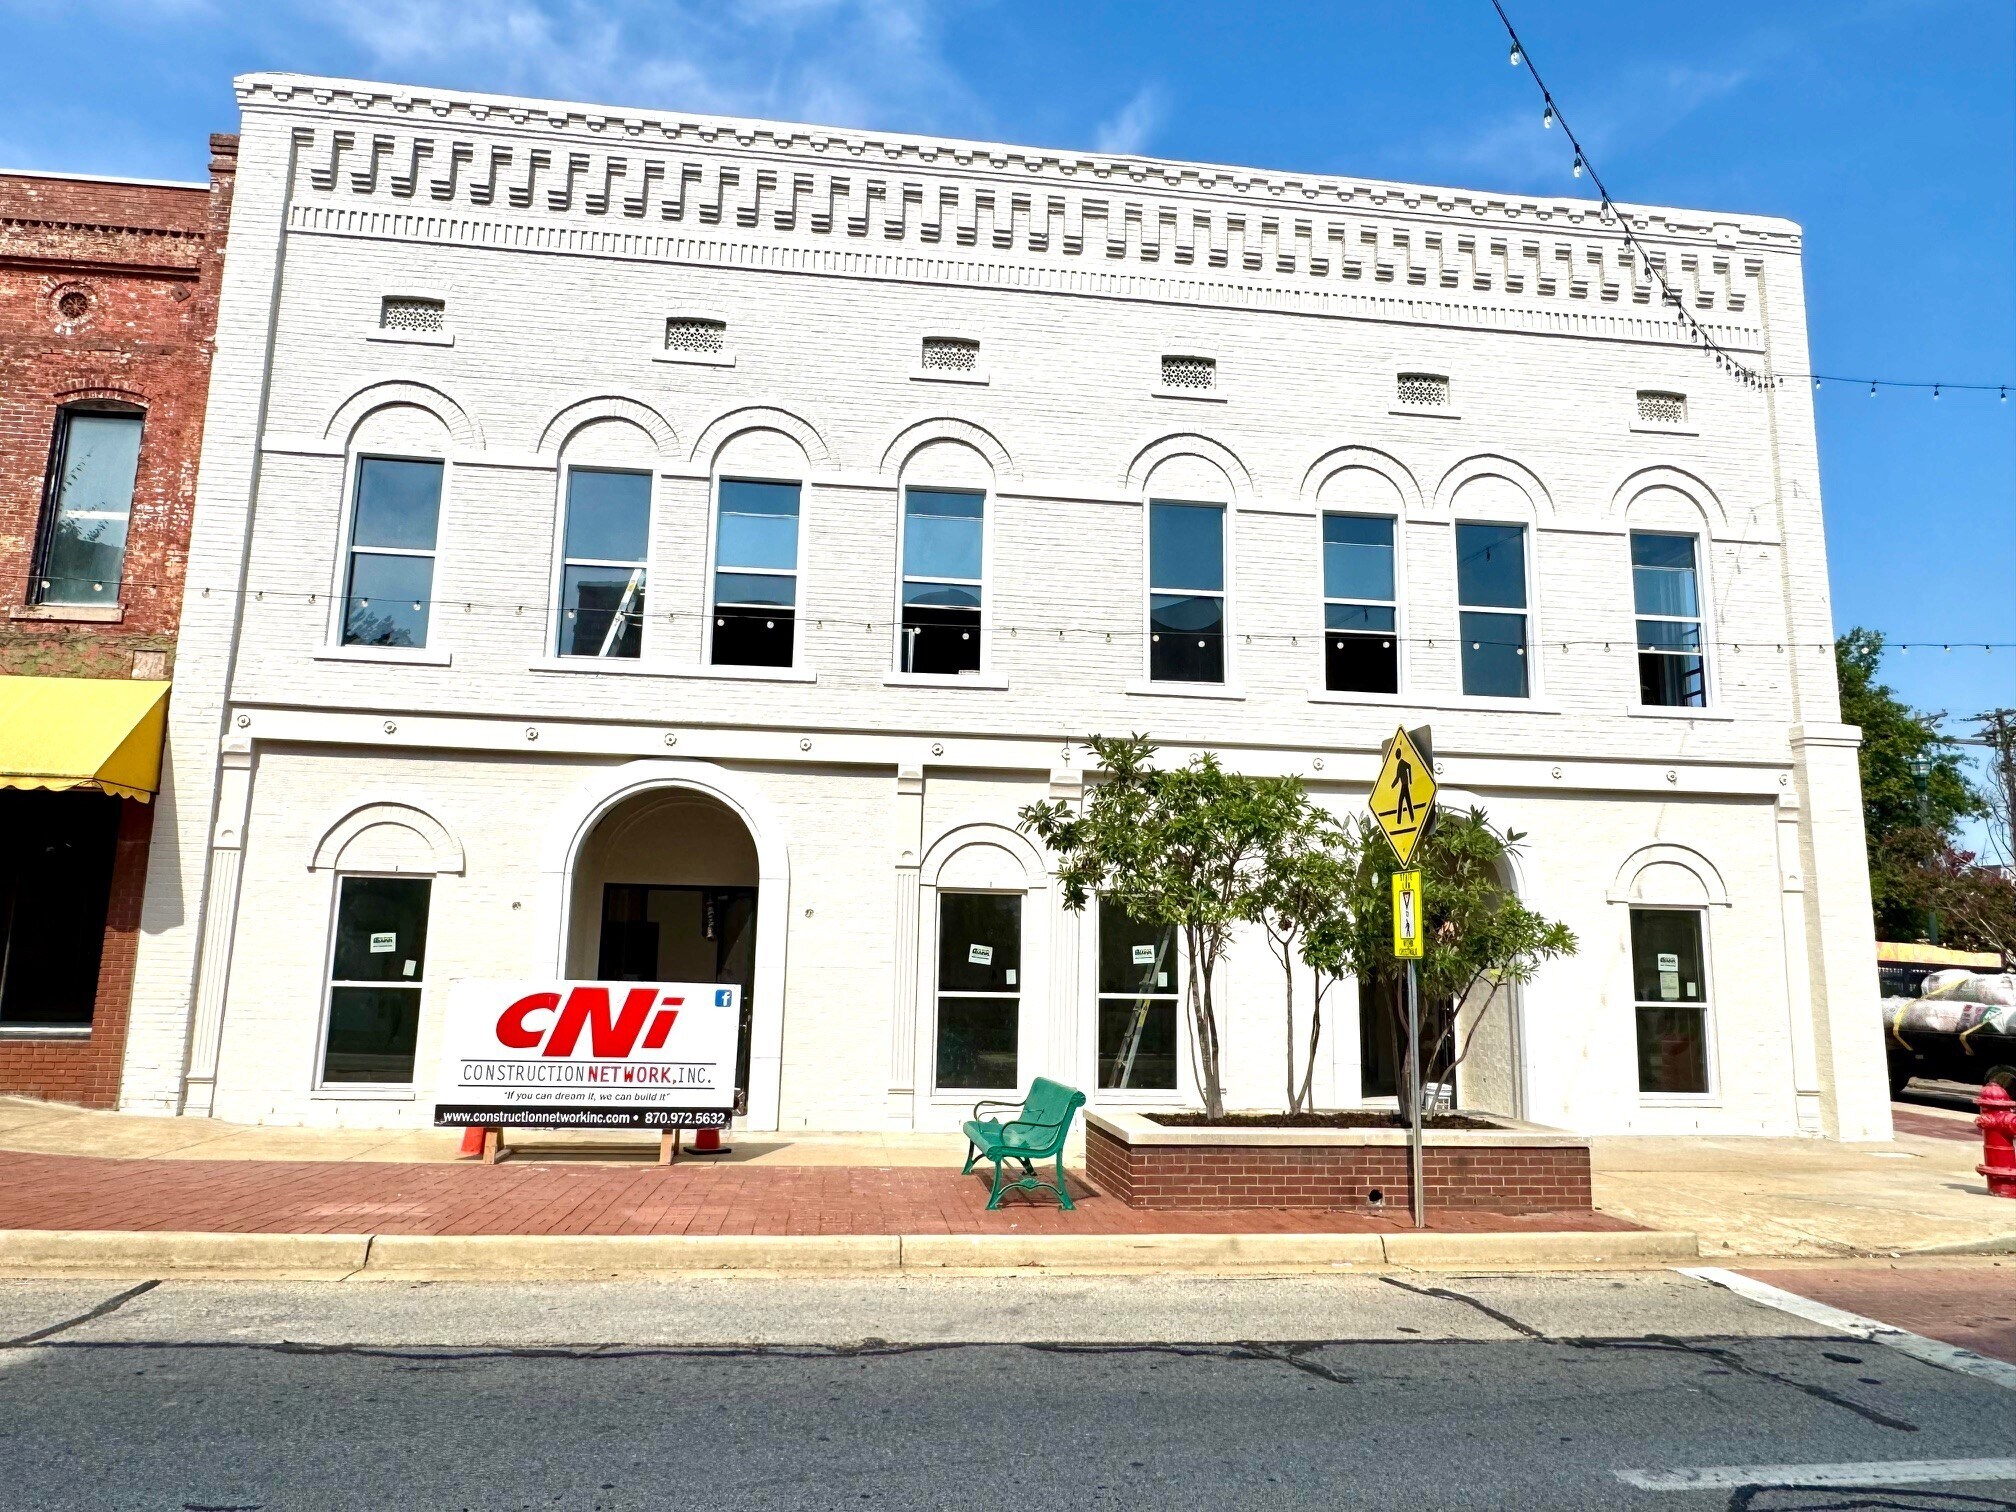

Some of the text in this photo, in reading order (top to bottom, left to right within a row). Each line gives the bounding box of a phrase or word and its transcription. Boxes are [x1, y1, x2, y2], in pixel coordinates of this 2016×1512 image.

[463, 1064, 585, 1082] CONSTRUCTION
[516, 1093, 533, 1102] you
[555, 1092, 586, 1101] dream
[615, 1093, 632, 1101] can
[634, 1092, 657, 1102] build
[443, 1110, 726, 1125] www.constructionnetworkinc.com 870.972.5632
